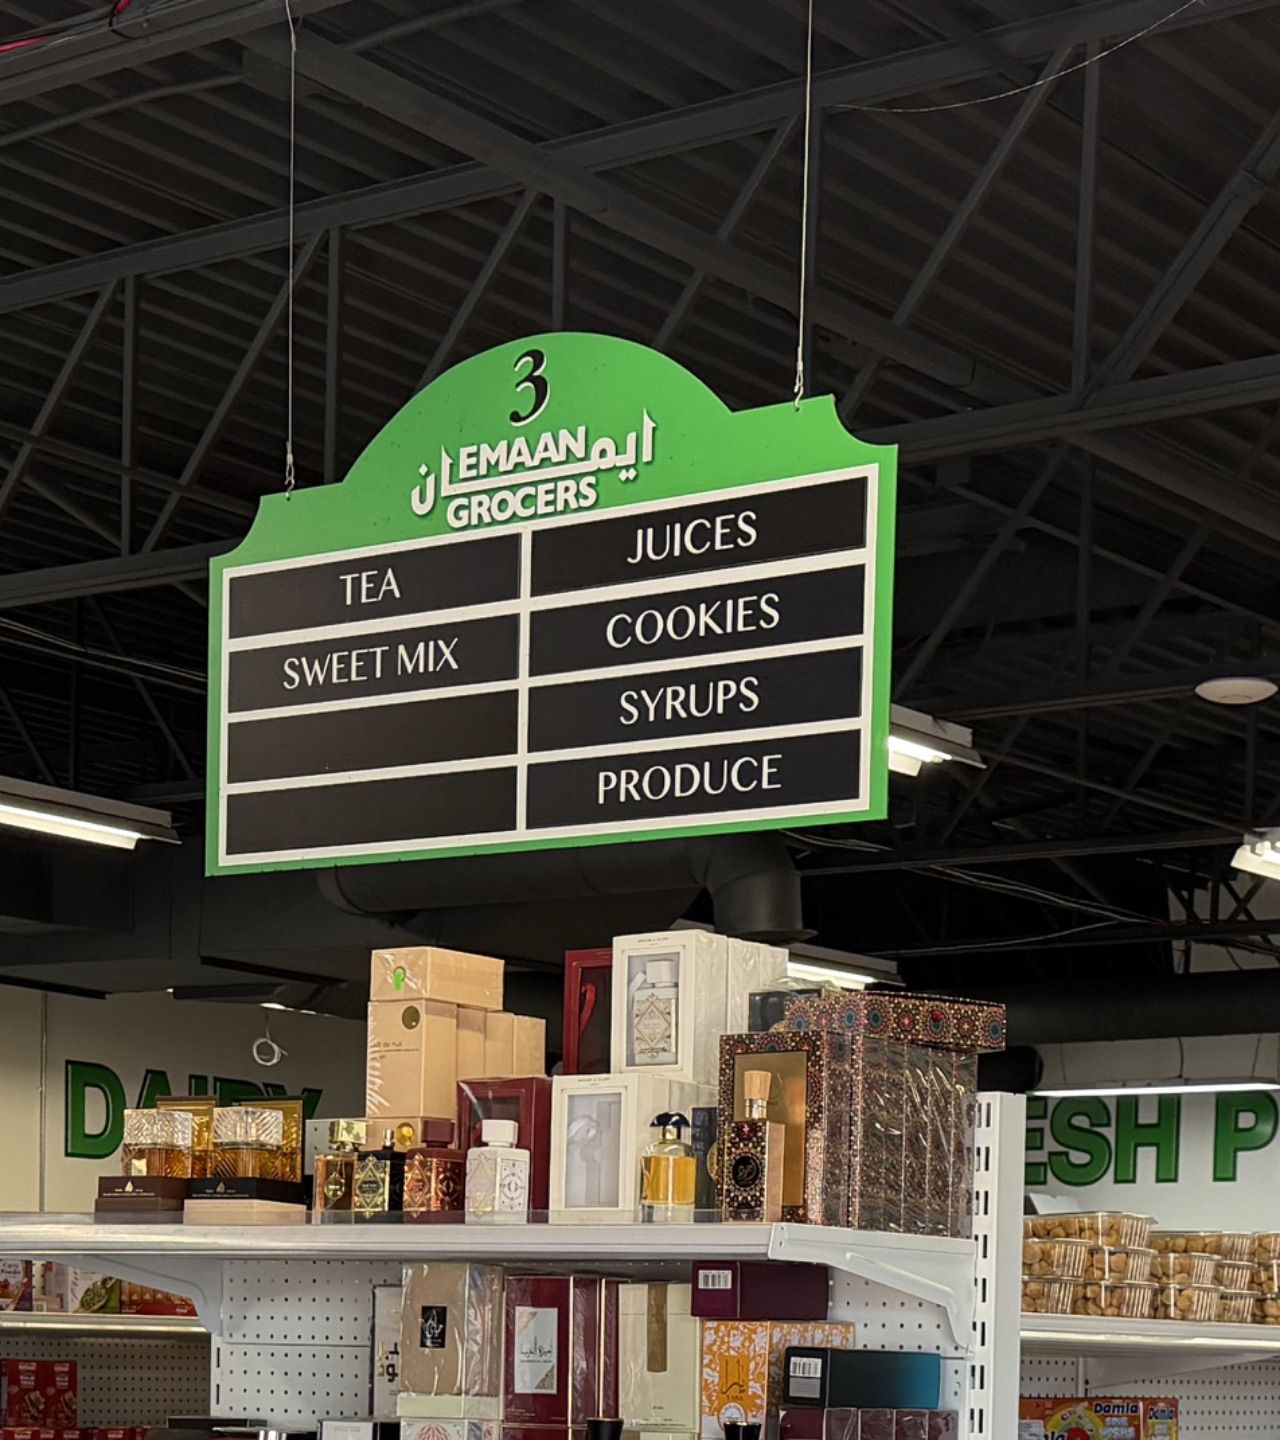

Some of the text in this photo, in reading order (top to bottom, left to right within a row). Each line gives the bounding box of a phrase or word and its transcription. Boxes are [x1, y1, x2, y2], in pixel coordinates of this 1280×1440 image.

[509, 349, 550, 426] 3
[459, 425, 587, 479] EMAAN
[446, 475, 598, 529] GROCERS
[626, 511, 758, 565] JUICES
[339, 567, 401, 606] TEA
[605, 593, 781, 650] COOKIES
[282, 638, 459, 690] SWEET MIX
[619, 676, 760, 725] SYRUPS
[597, 754, 782, 804] PRODUCE
